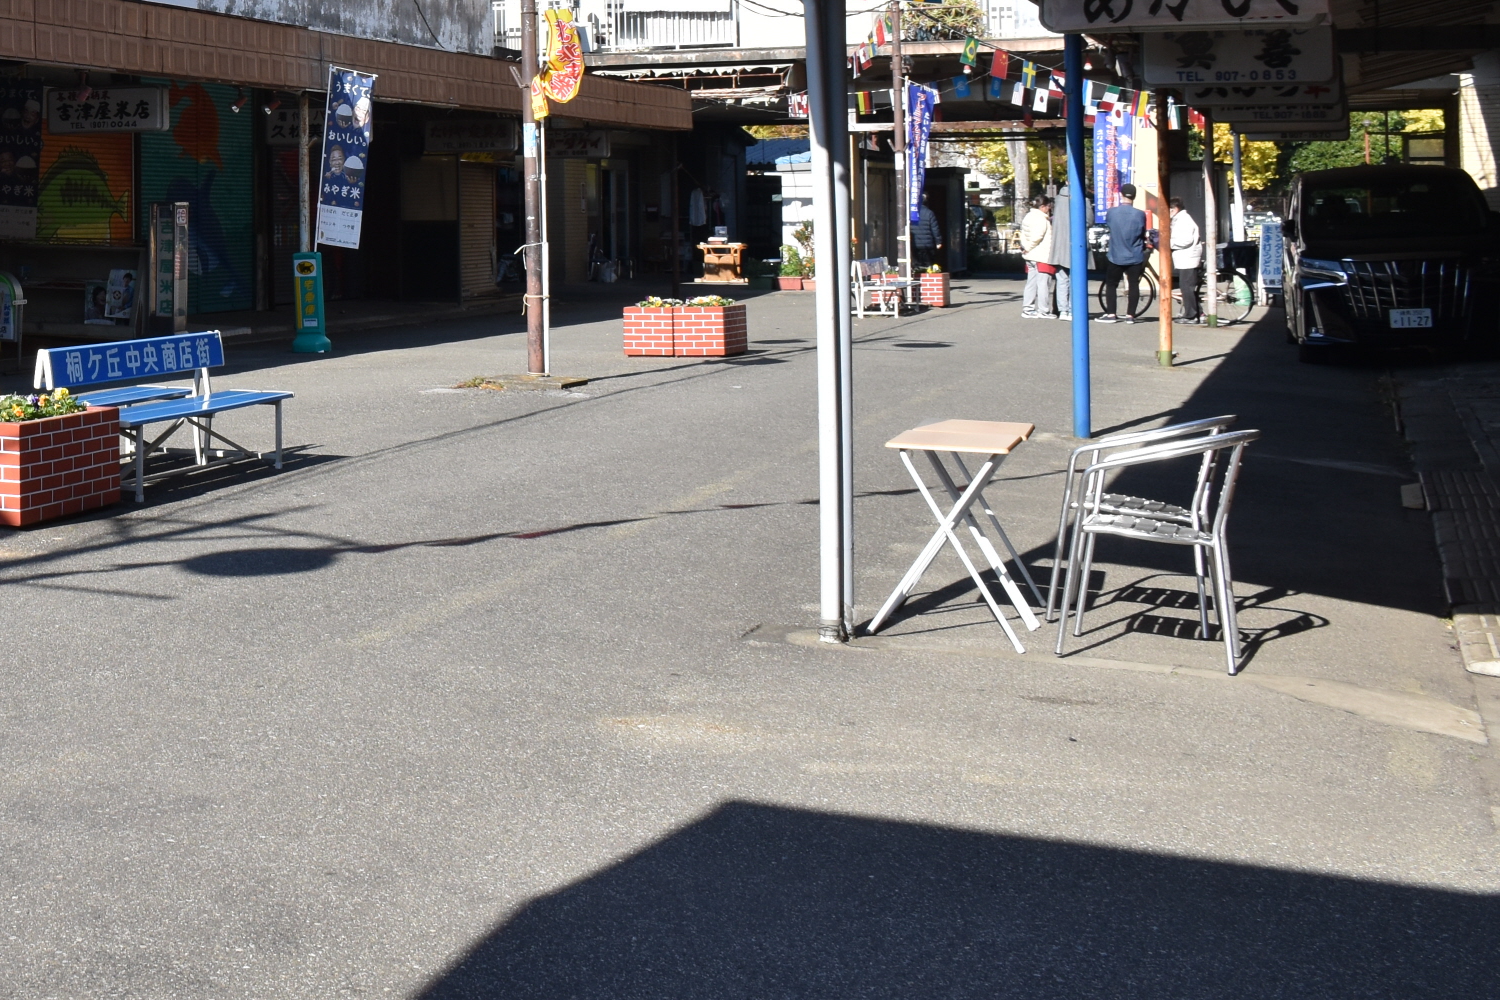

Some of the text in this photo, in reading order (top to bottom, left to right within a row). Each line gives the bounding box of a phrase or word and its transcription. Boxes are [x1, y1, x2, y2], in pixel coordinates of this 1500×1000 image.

[1176, 70, 1297, 82] TEL 907-0853
[56, 99, 150, 121] 吉津屋米店
[323, 184, 361, 200] みやぎ米
[160, 219, 173, 314] 吉津屋米店
[1401, 316, 1430, 327] 11-27
